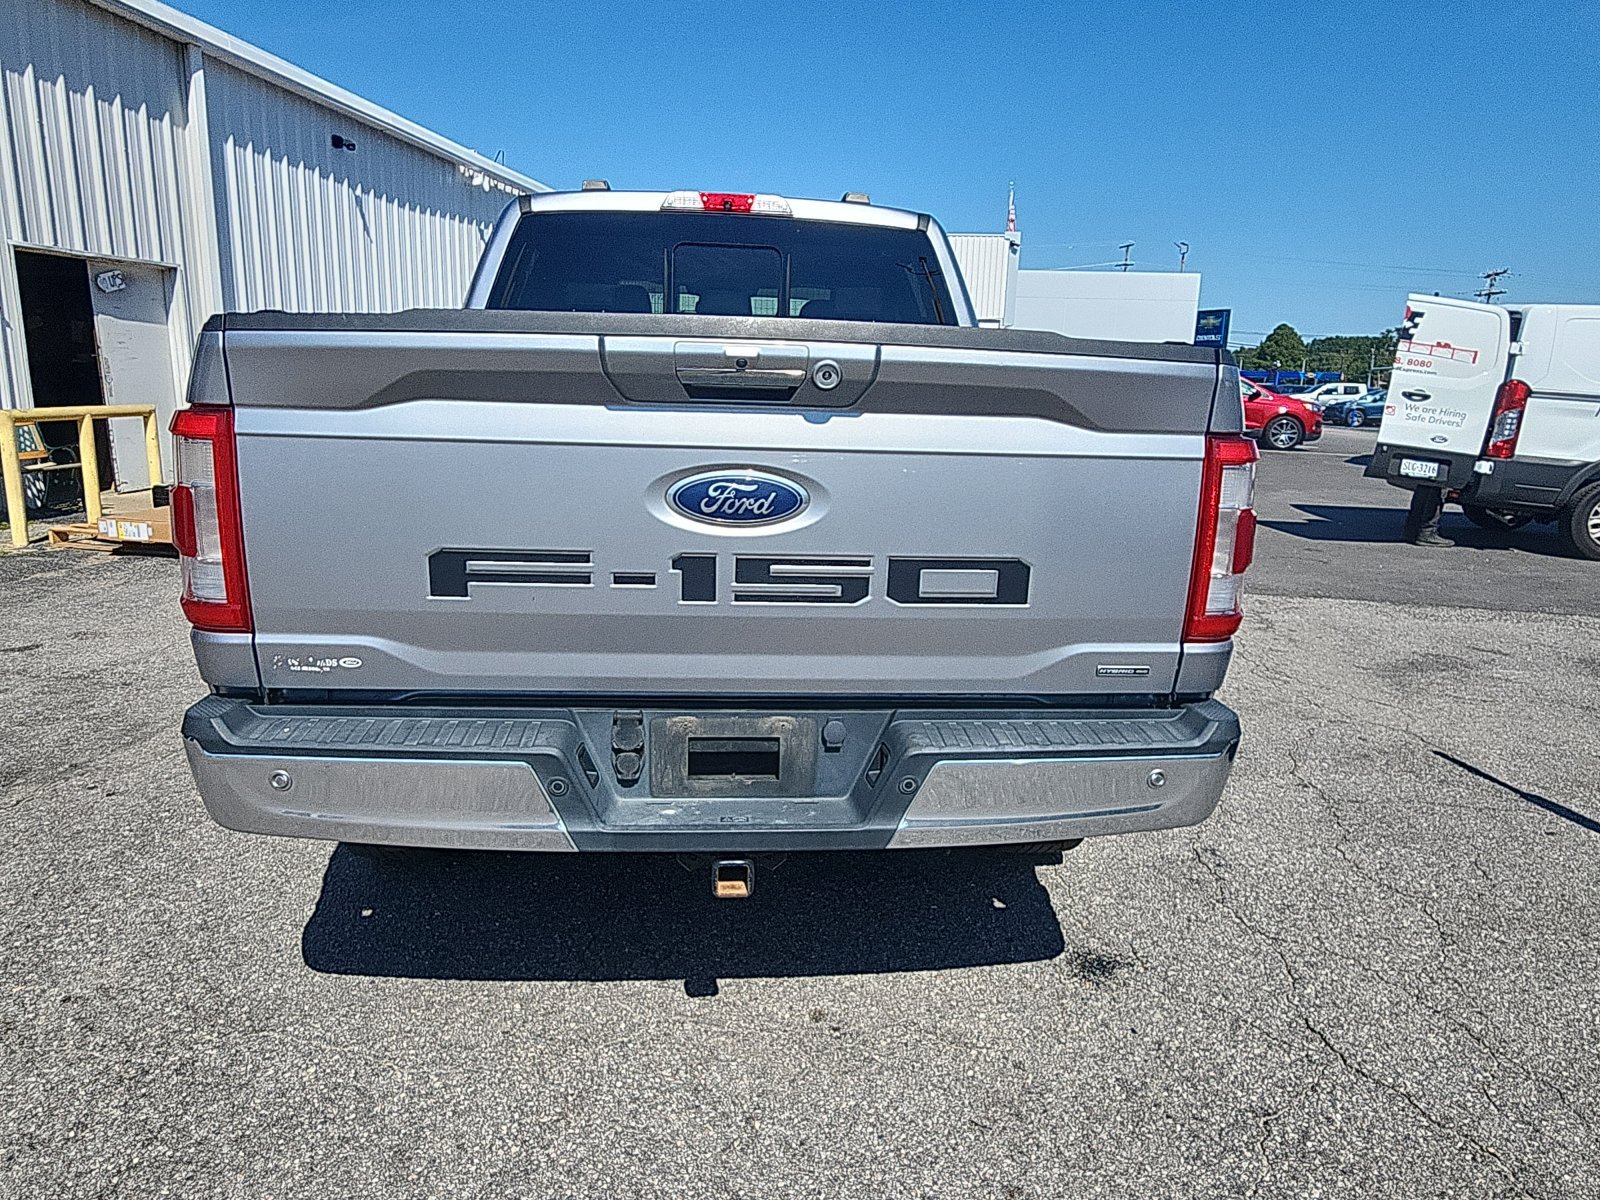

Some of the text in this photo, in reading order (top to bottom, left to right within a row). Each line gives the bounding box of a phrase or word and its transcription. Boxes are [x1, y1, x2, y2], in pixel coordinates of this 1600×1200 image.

[1407, 358, 1432, 368] 8080
[1405, 403, 1420, 412] We
[1438, 408, 1467, 420] Hiring
[1405, 412, 1464, 427] Safe Drivers!
[700, 481, 777, 515] Ford
[425, 547, 1033, 608] F-150
